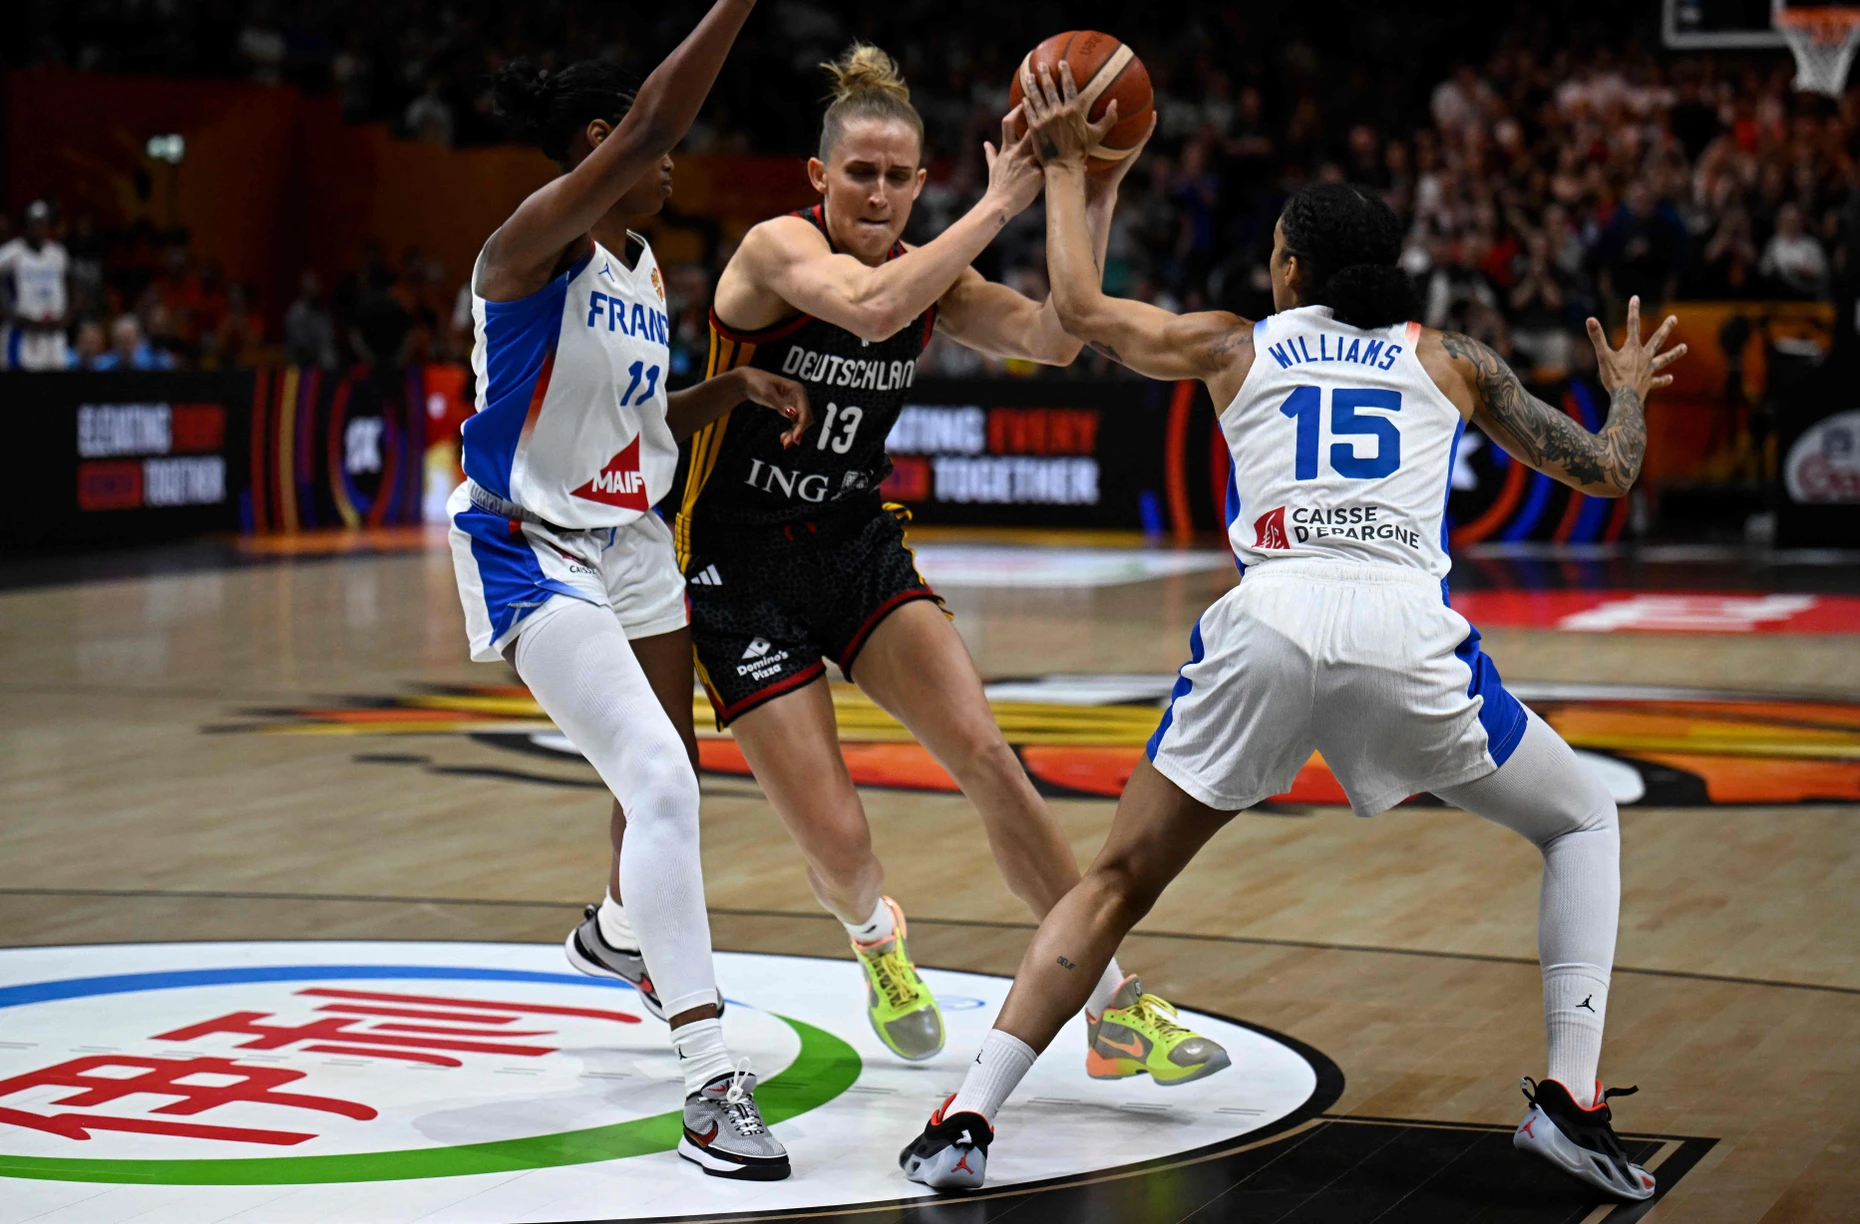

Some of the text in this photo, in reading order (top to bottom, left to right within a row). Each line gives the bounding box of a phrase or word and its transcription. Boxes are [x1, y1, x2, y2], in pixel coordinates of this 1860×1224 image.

[587, 290, 669, 349] FRANC
[782, 345, 918, 391] DEUTSCHLAN
[1268, 334, 1403, 371] WILLIAMS
[620, 360, 660, 407] 11
[817, 402, 863, 454] 13
[1279, 385, 1402, 481] 15
[591, 470, 643, 494] MAIF
[744, 458, 829, 503] ING
[1292, 506, 1378, 525] CAISSE
[736, 650, 789, 677] Domino's
[751, 664, 782, 681] Pizza
[0, 986, 643, 1147] 伊利
